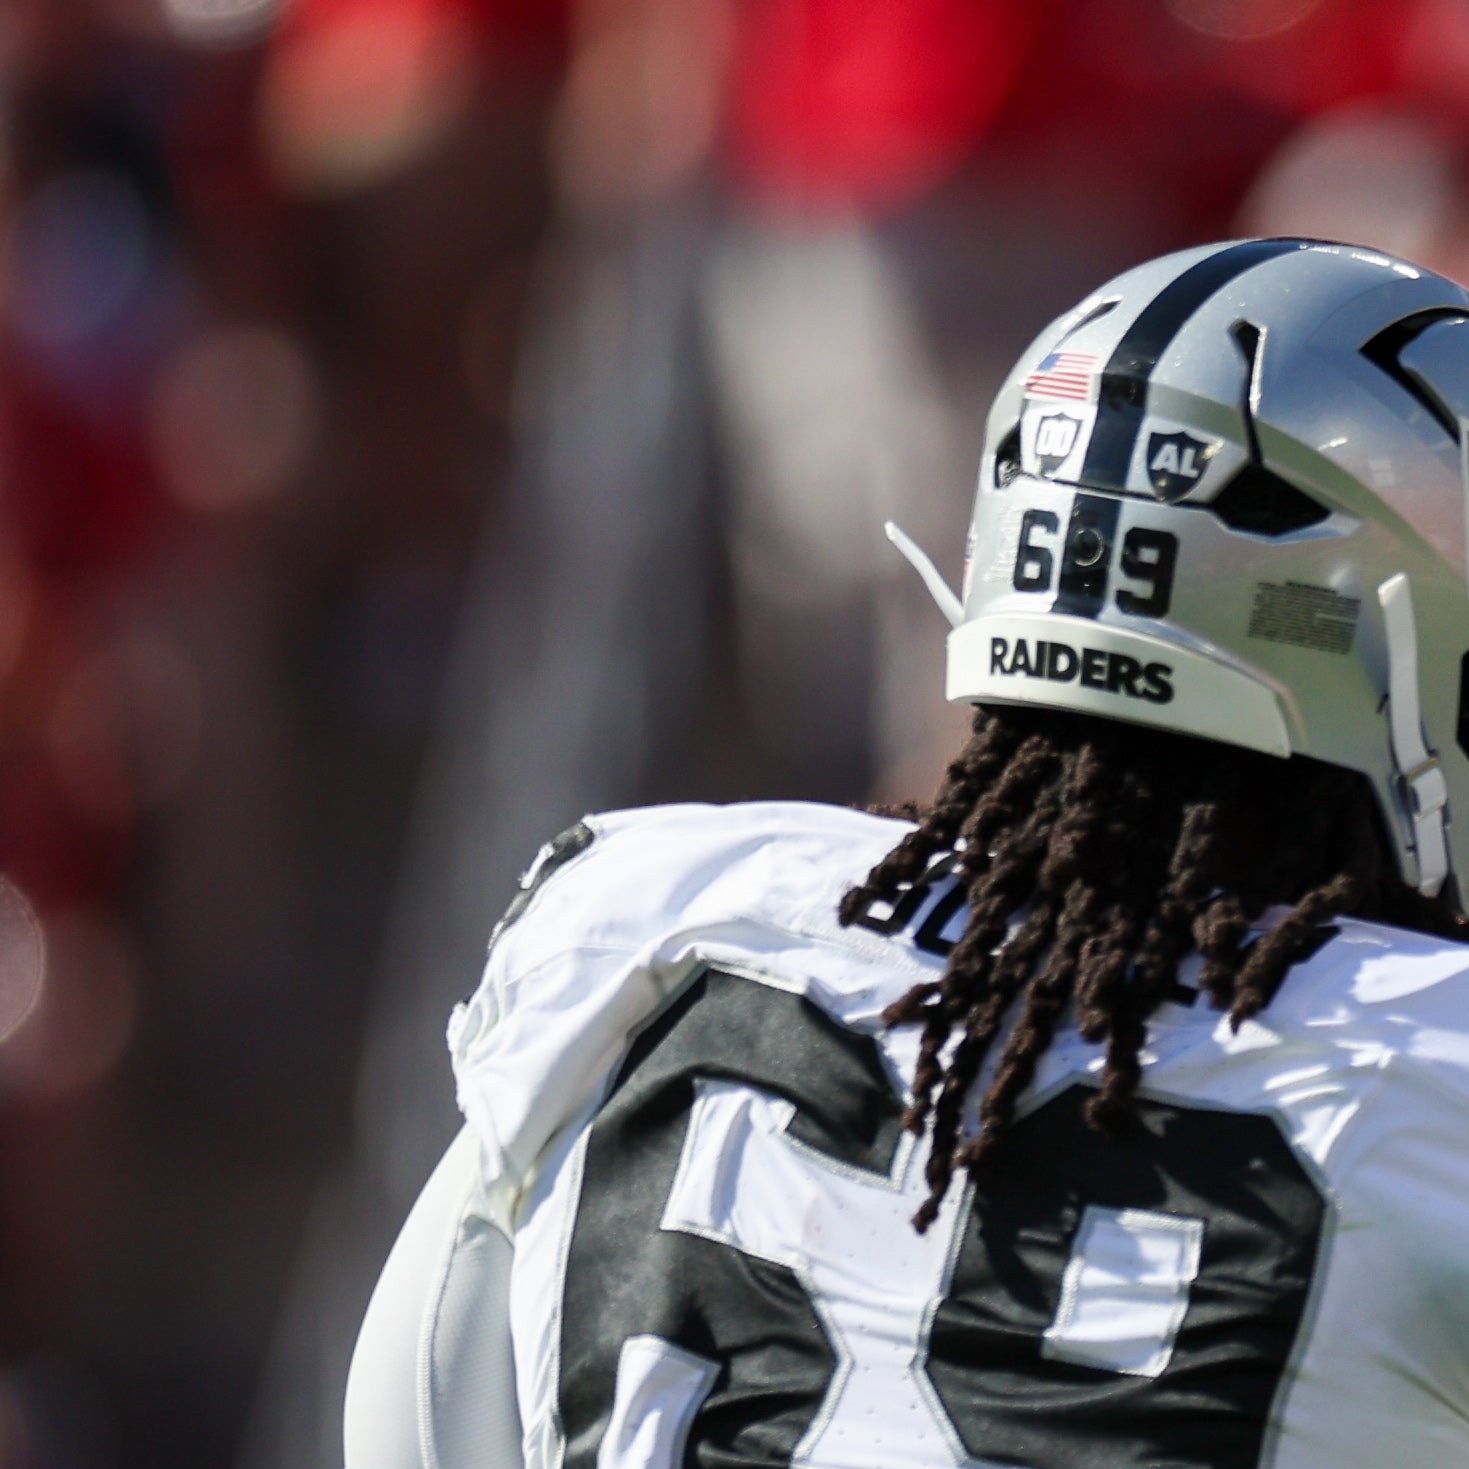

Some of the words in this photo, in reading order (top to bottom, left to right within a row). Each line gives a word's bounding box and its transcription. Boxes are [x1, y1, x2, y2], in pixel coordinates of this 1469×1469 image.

[1149, 443, 1200, 478] AL
[1013, 509, 1180, 619] 69
[989, 637, 1175, 705] RAIDERS
